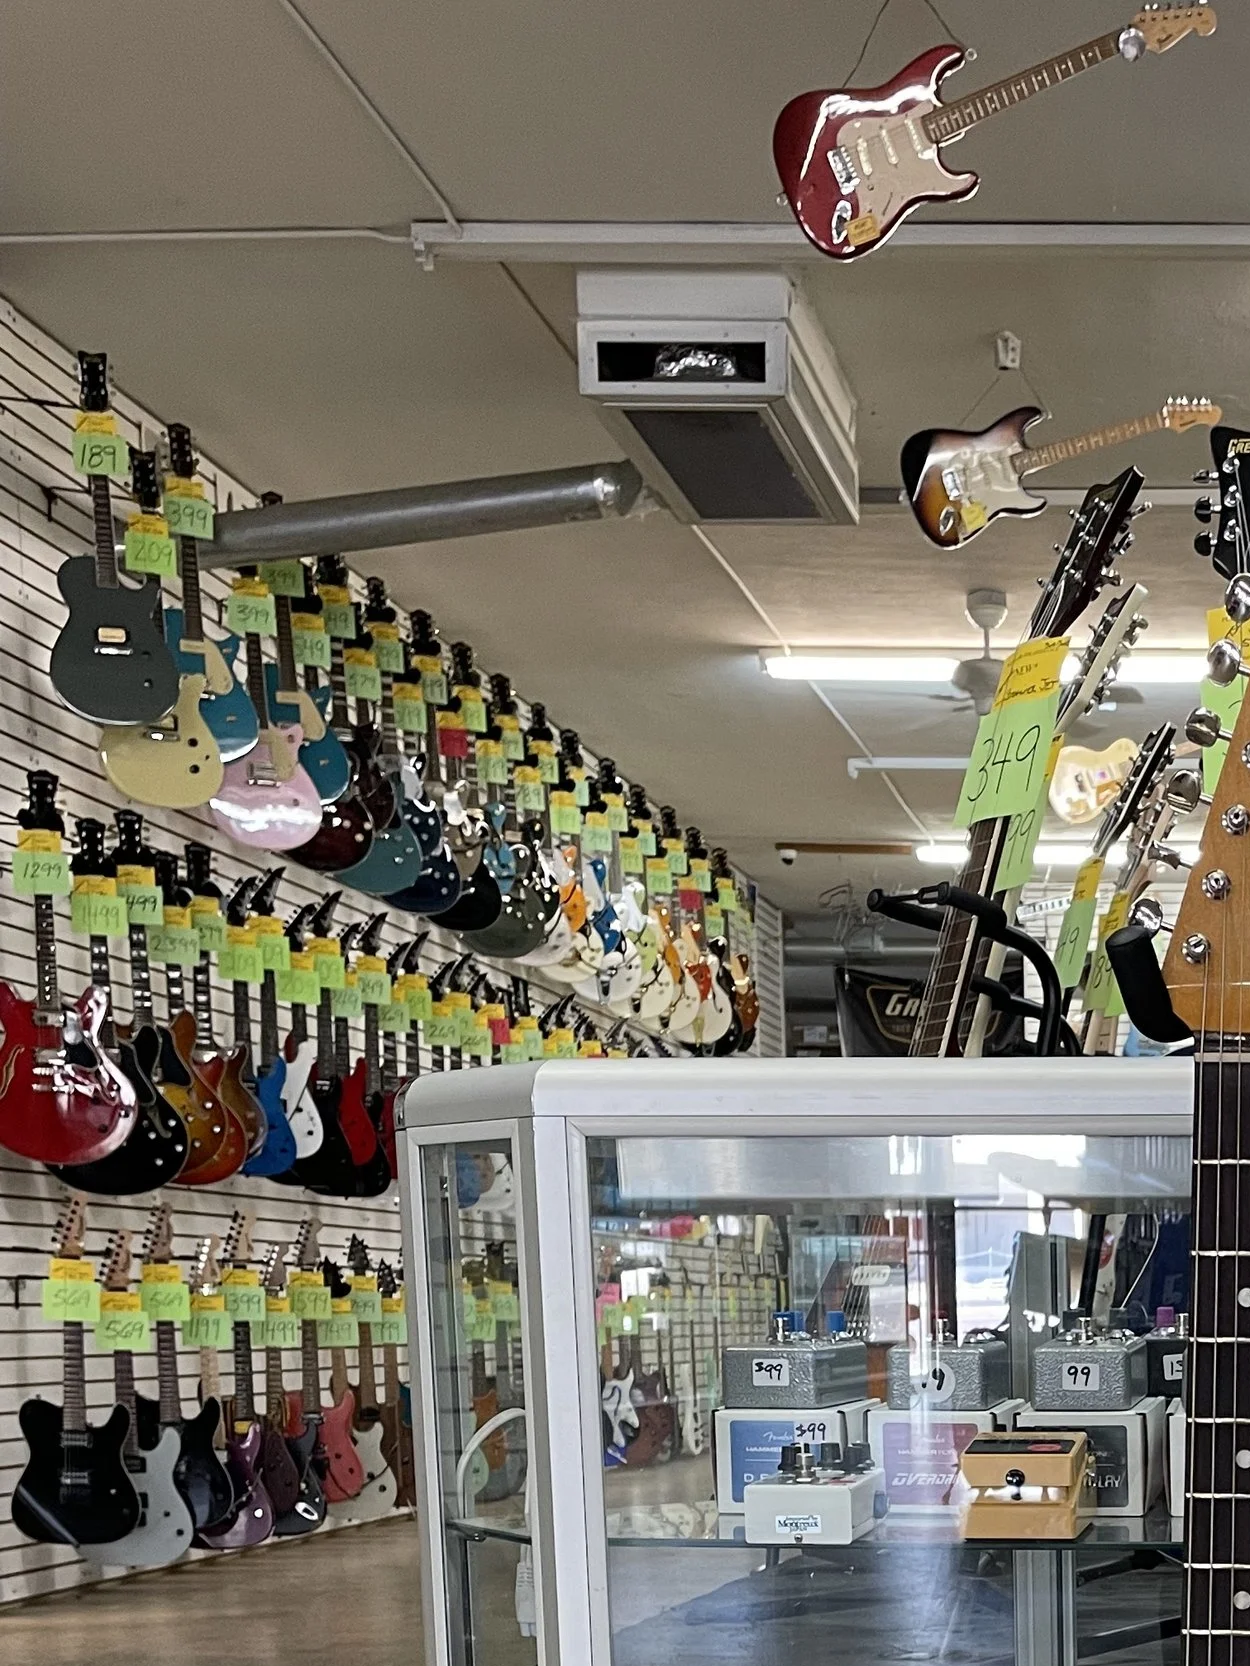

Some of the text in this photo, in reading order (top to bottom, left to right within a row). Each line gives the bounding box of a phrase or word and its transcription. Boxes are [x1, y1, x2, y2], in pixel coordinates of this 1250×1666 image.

[79, 443, 118, 473] 189
[167, 500, 208, 531] 399
[130, 538, 173, 569] 209
[235, 602, 271, 625] 399
[966, 724, 1042, 803] 349
[22, 861, 63, 879] 1299
[81, 905, 121, 936] 1499
[105, 1319, 145, 1342] 569
[754, 1361, 784, 1381] $99
[1066, 1365, 1092, 1387] 99
[795, 1422, 827, 1441] $99
